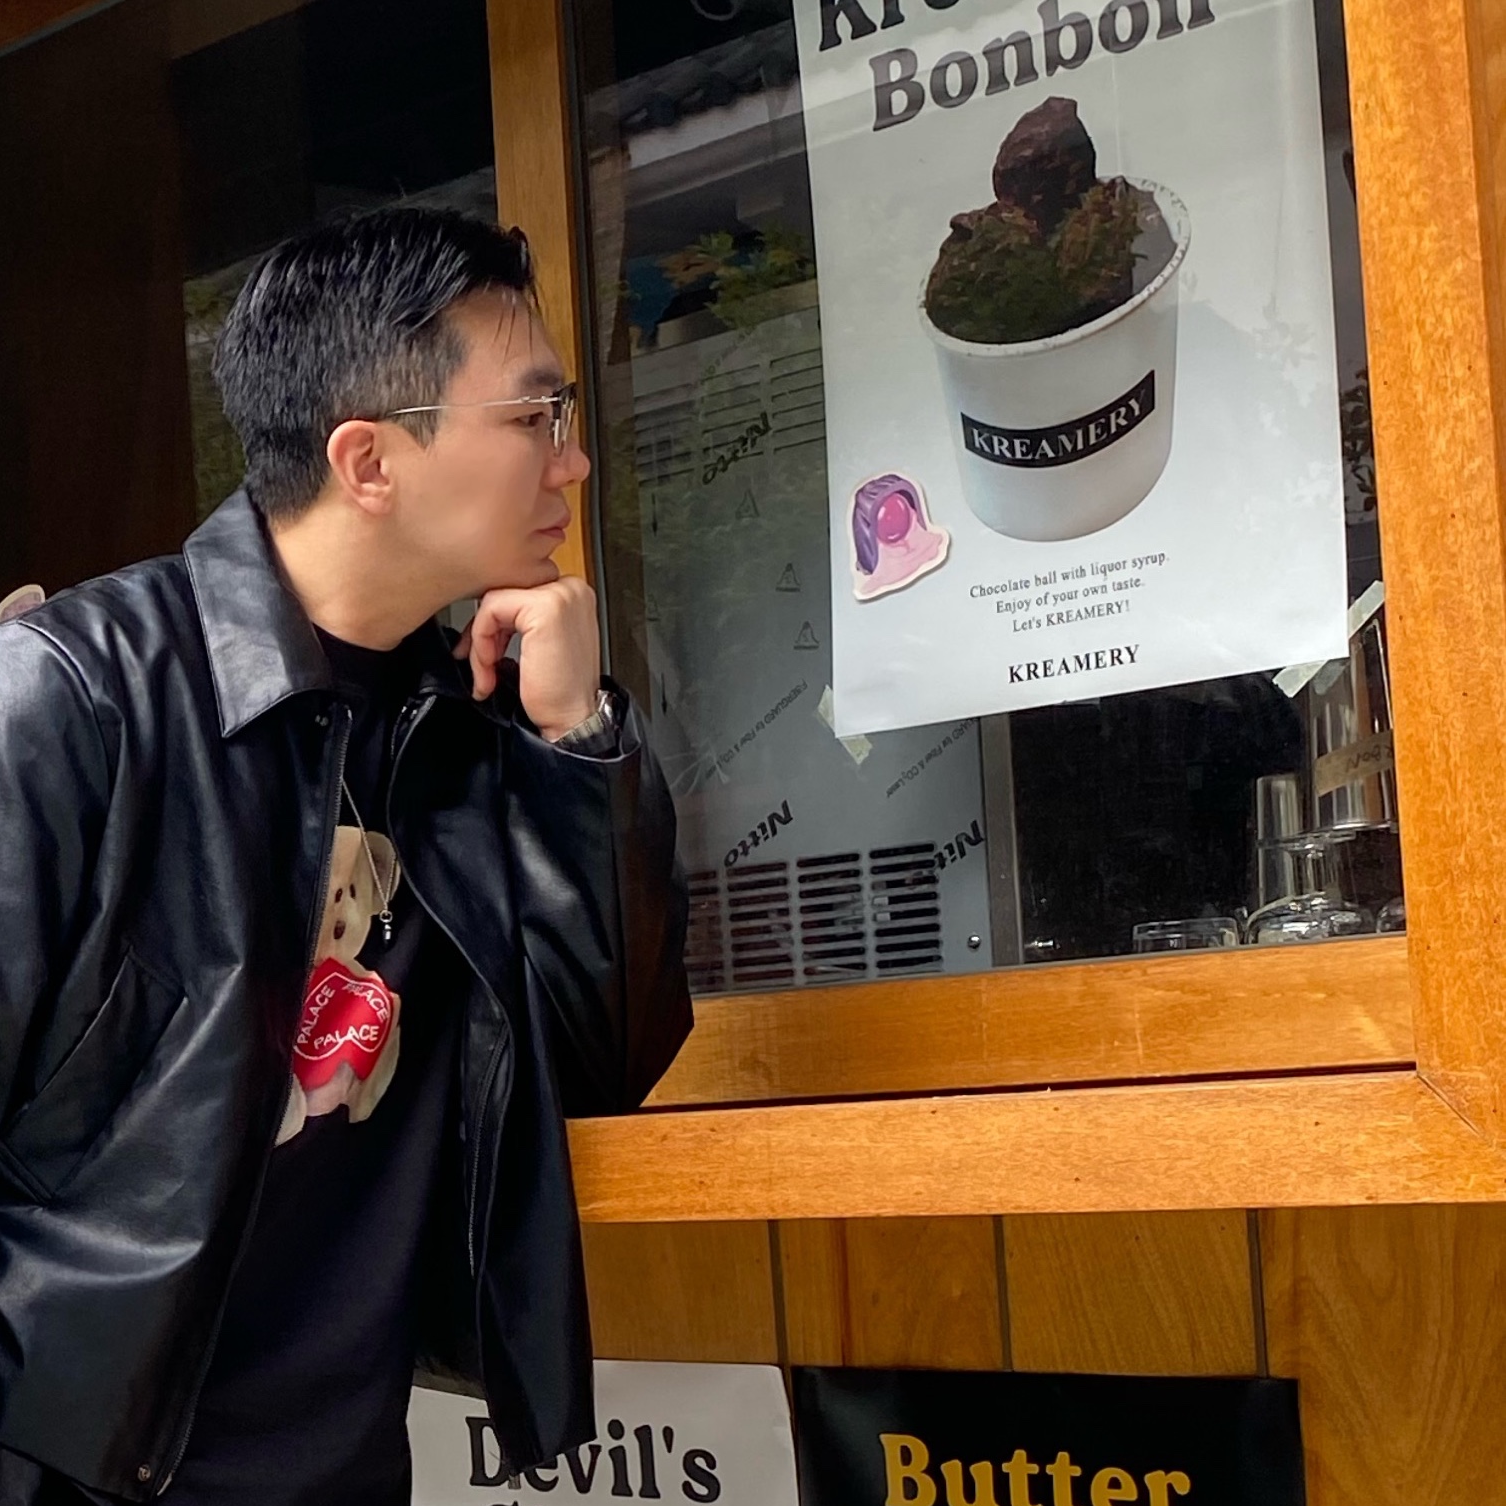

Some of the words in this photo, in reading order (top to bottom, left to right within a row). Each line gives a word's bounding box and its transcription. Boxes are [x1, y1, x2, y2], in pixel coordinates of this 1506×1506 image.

[971, 396, 1146, 460] KREAMERY
[969, 579, 1031, 598] Chocolate
[1034, 570, 1057, 587] ball
[1060, 565, 1087, 581] with
[1090, 560, 1127, 581] liquor
[996, 599, 1032, 615] Enjoy
[1035, 591, 1050, 607] of
[1052, 589, 1079, 607] your
[1082, 584, 1108, 598] own
[1012, 616, 1042, 633] Let's
[1046, 599, 1129, 627] KREAMERY!
[1008, 644, 1141, 684] KREAMERY
[723, 799, 794, 869] Nitto
[296, 985, 336, 1044] PALACE
[313, 1024, 380, 1050] PALACE
